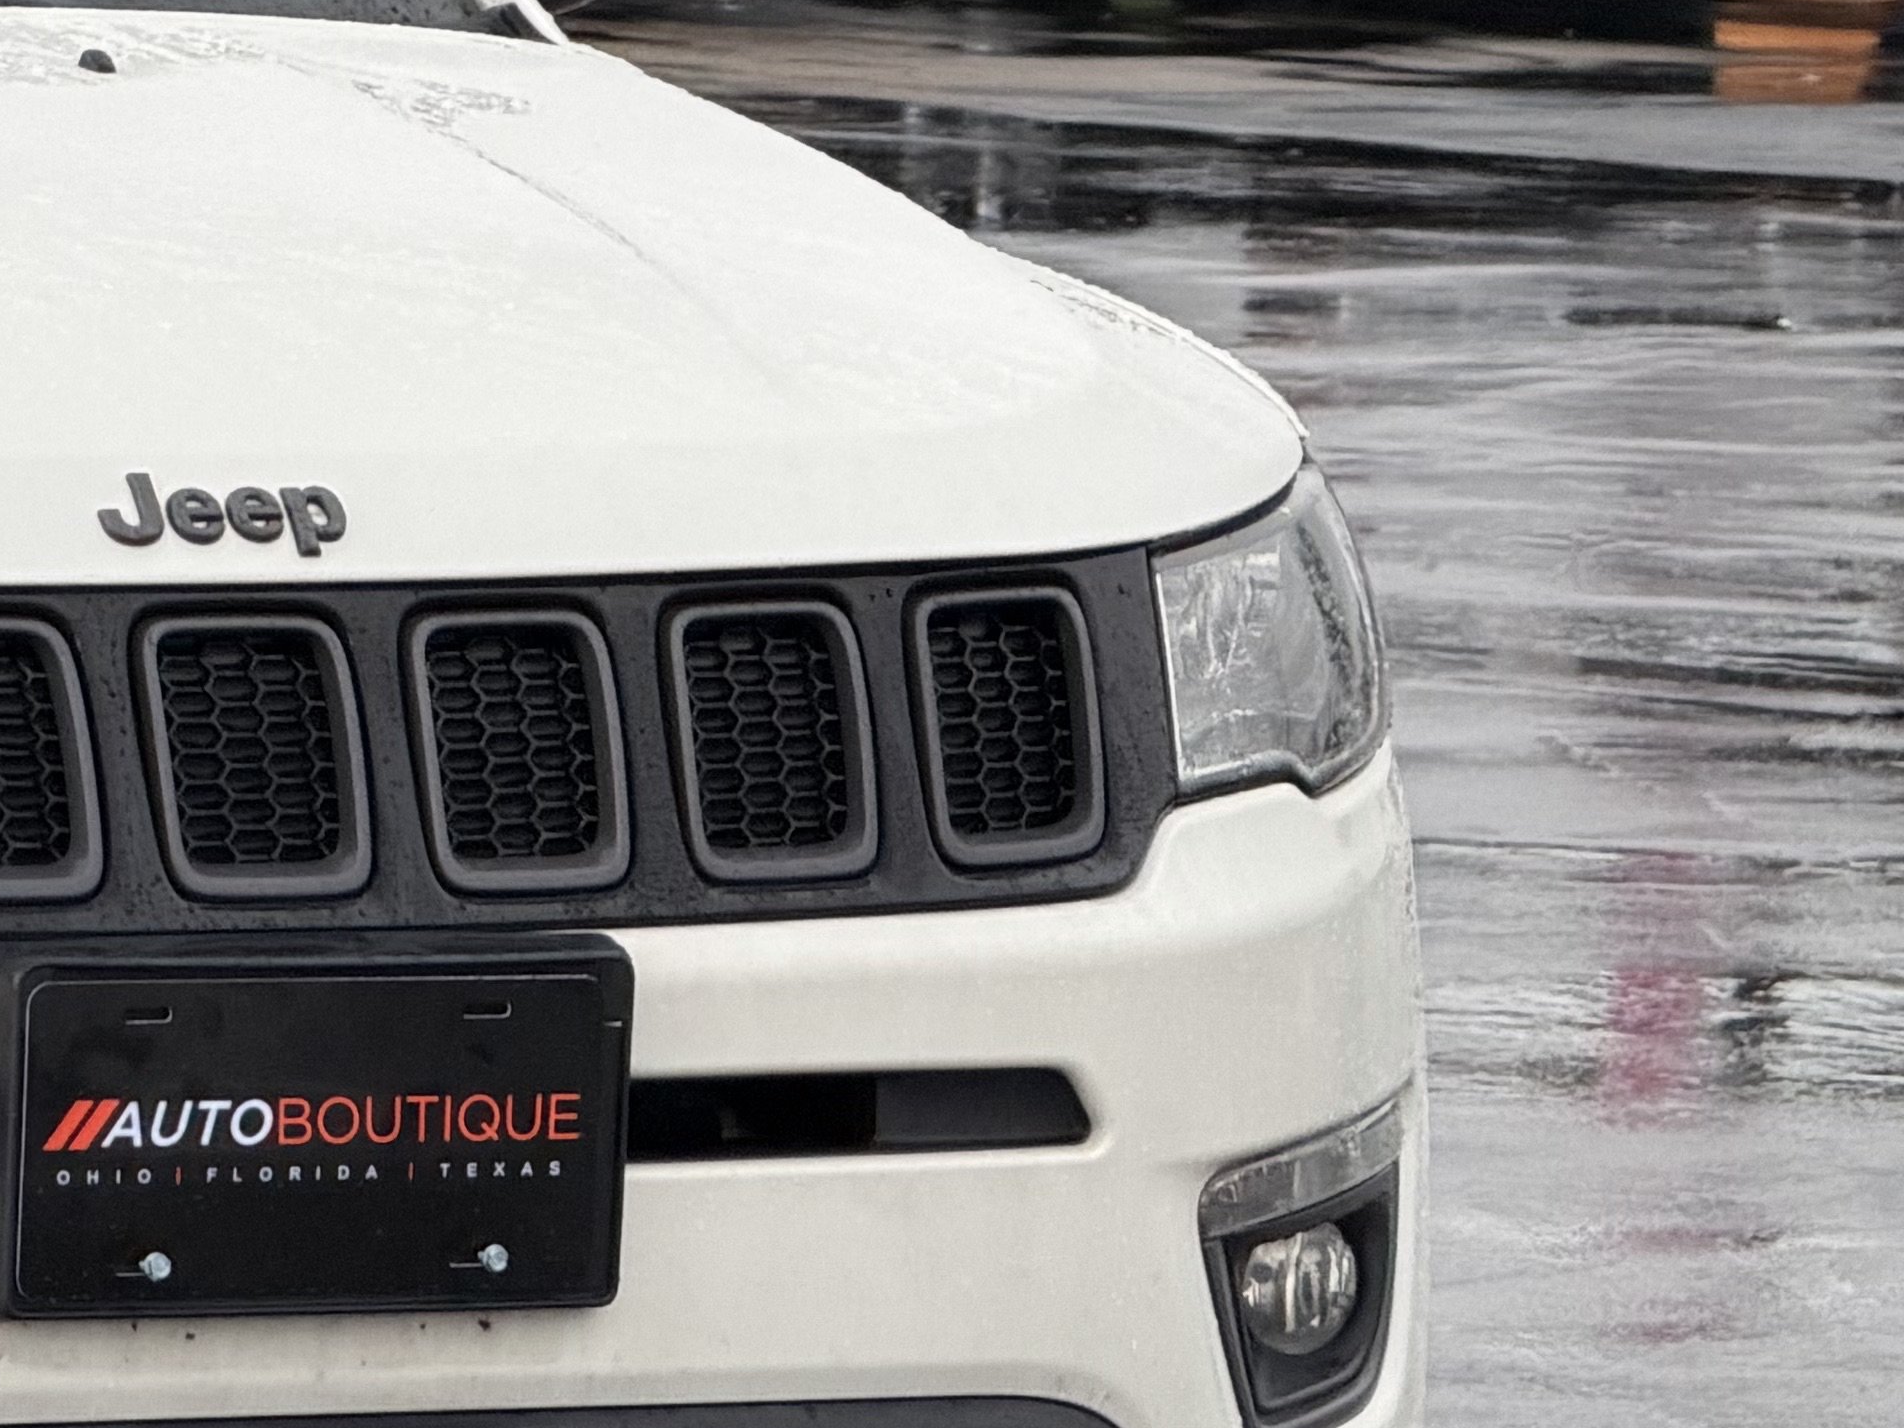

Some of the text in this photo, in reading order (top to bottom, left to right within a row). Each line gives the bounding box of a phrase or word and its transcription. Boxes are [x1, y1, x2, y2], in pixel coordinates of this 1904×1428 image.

[96, 471, 348, 559] Jeep
[101, 1093, 581, 1148] AUTOBOUTIQUE
[56, 1159, 562, 1186] OHIO FLORIDA TEXAS
